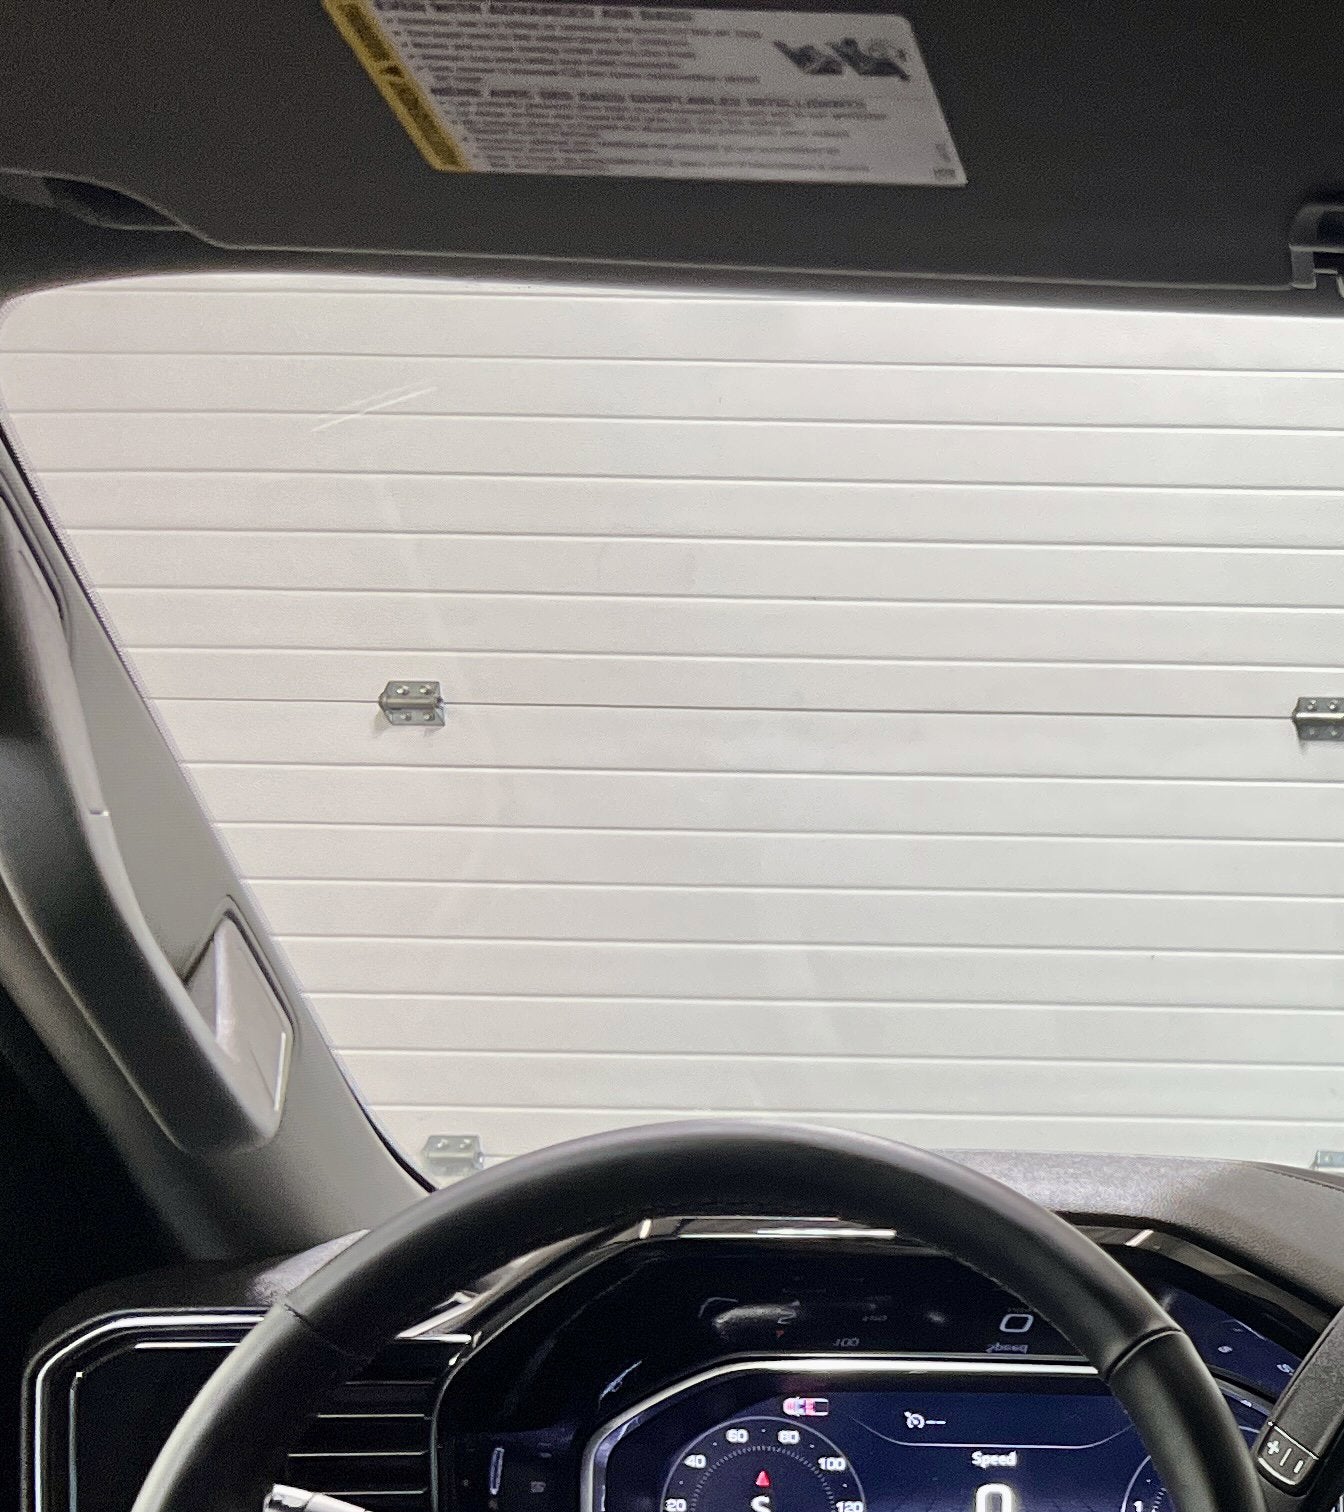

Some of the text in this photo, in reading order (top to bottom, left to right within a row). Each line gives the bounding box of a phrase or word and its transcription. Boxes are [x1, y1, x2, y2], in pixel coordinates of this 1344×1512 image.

[726, 1429, 749, 1443] 60
[778, 1430, 800, 1444] 80
[684, 1454, 707, 1469] 40
[818, 1457, 847, 1471] 100
[971, 1451, 1017, 1470] Speed
[665, 1498, 687, 1512] 20
[1133, 1500, 1143, 1512] 1
